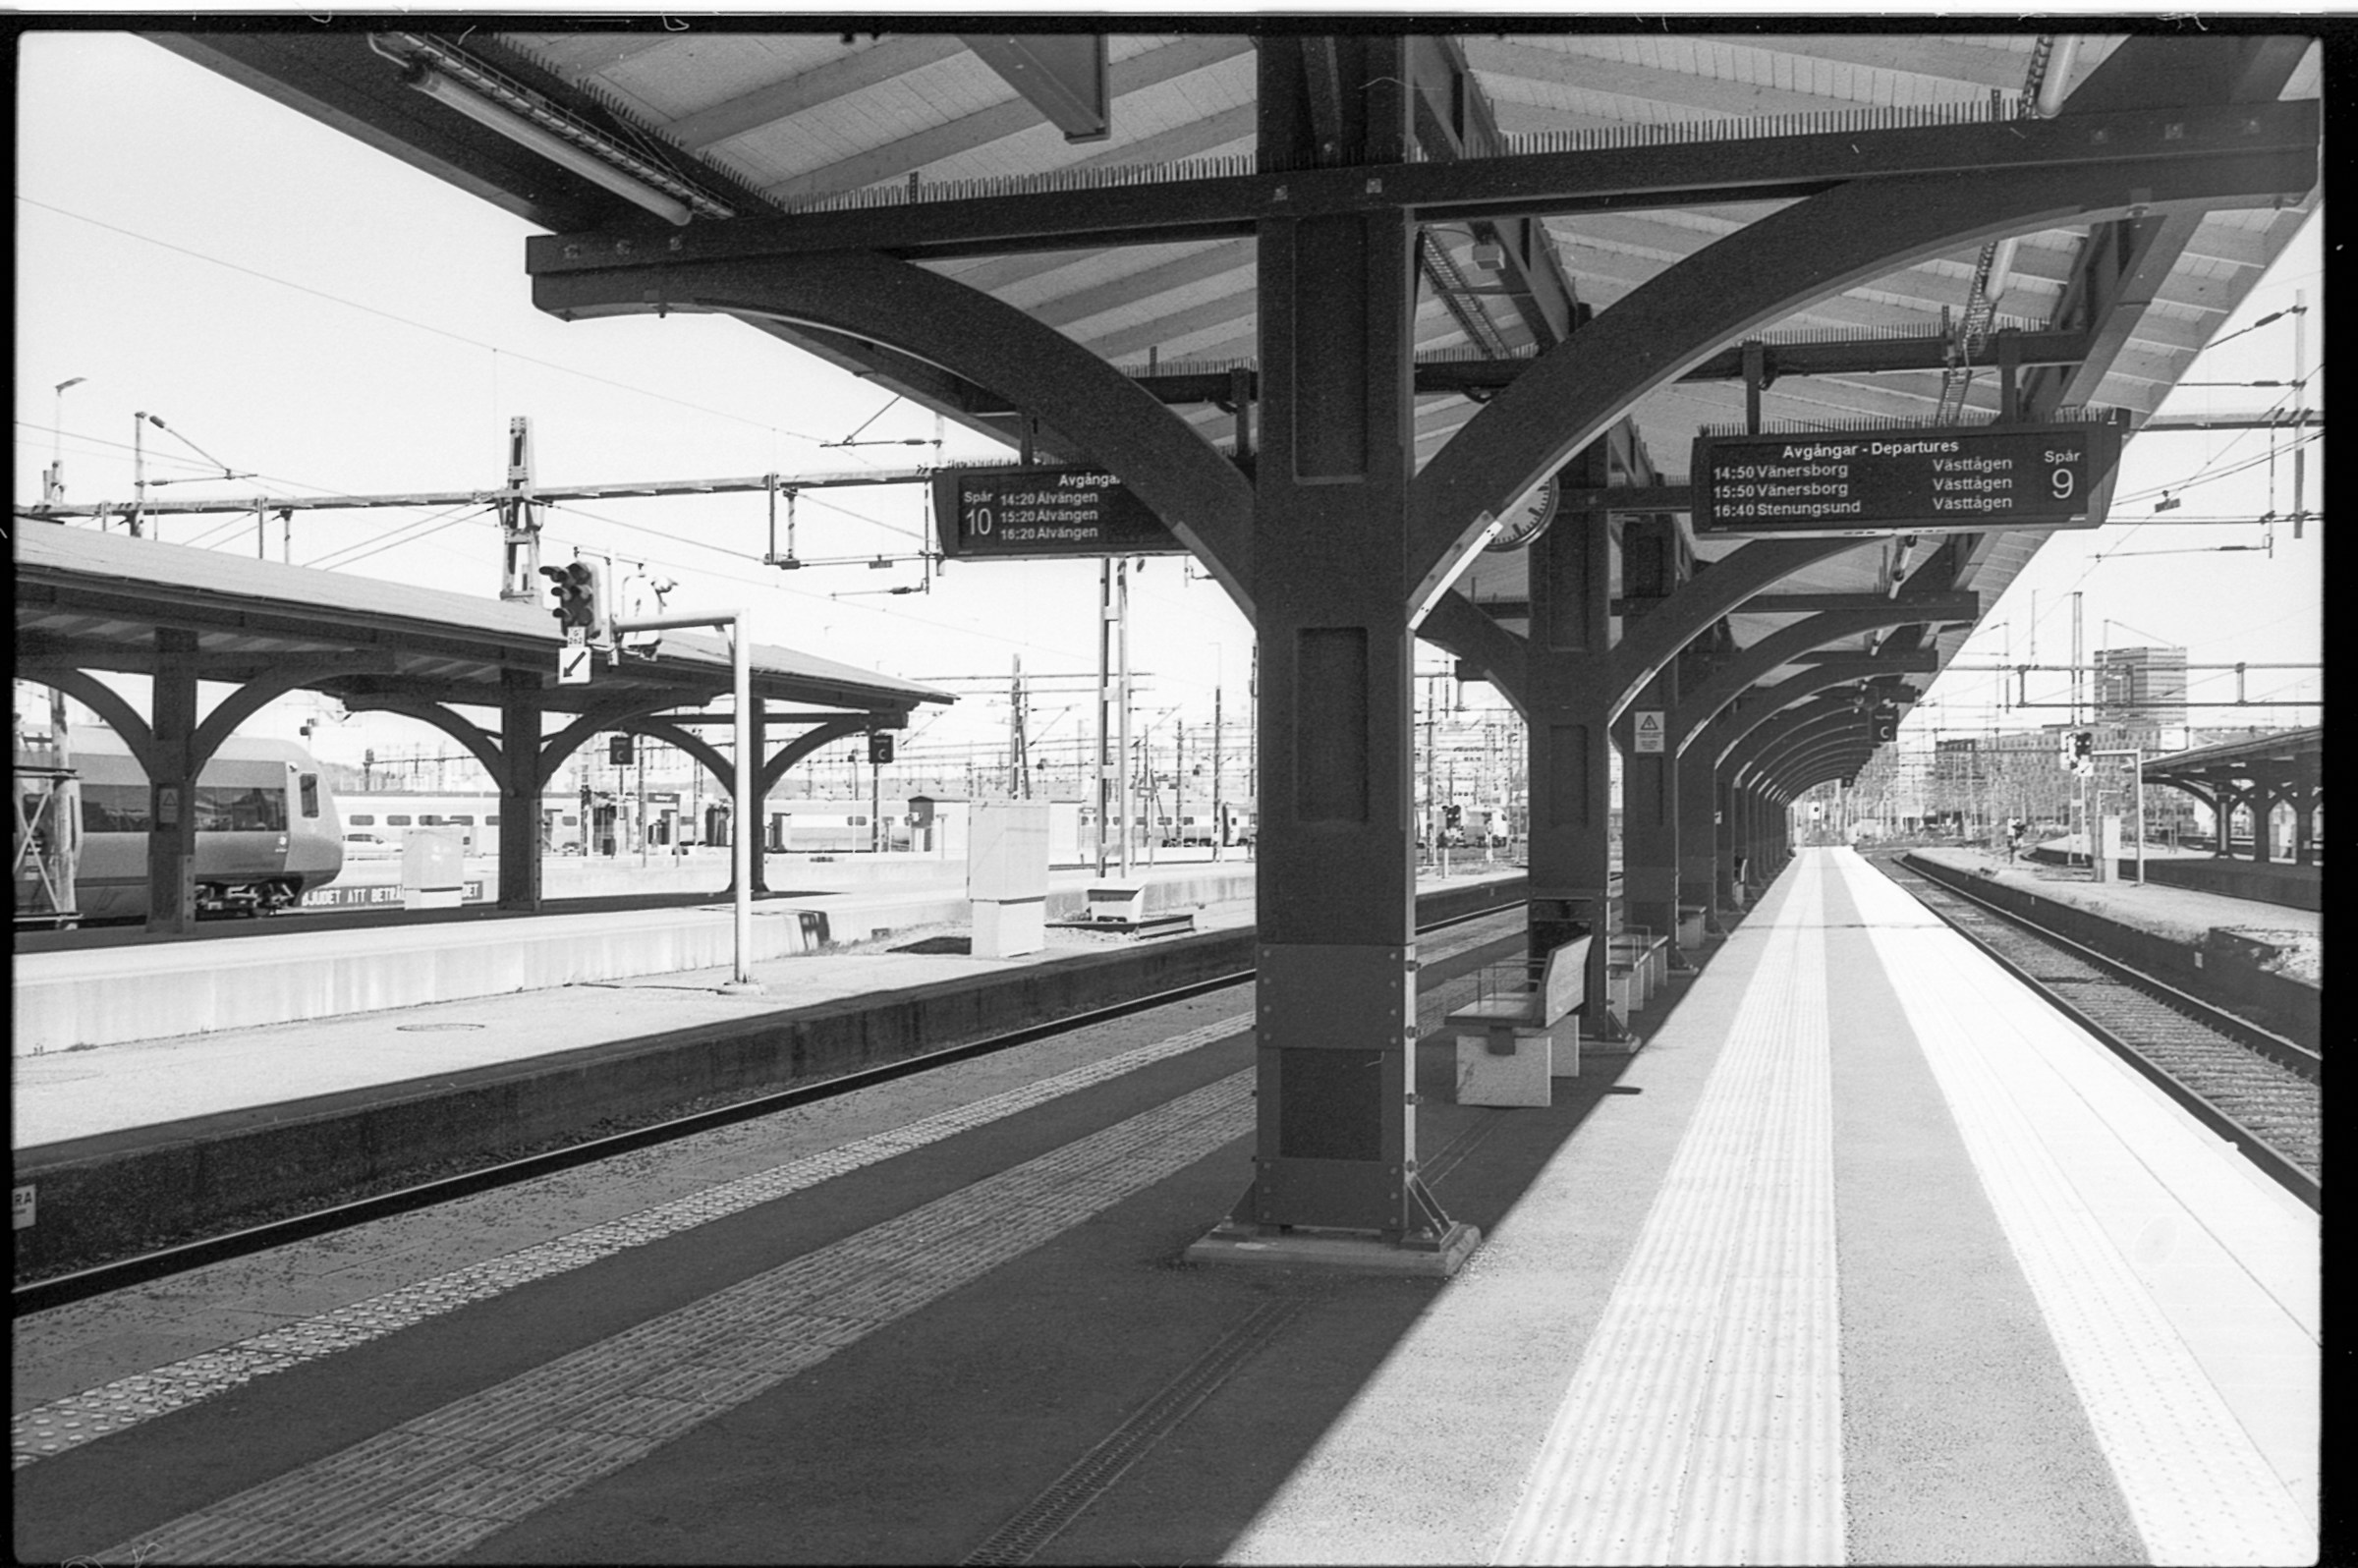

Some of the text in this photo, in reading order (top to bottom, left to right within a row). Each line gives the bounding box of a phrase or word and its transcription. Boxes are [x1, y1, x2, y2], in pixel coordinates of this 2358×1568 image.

[1782, 444, 1859, 461] Avgångar
[1871, 441, 1959, 458] Departures
[2045, 449, 2082, 466] Spår
[1713, 456, 2013, 479] 14:50 Vänersborg Västtågen
[1059, 472, 1120, 488] Avgånga
[1713, 476, 2013, 498] 15:50 Vänersborg Västtågen
[2052, 468, 2074, 499] 9
[964, 490, 993, 505] Spår
[1000, 492, 1036, 506] 14:20
[1713, 495, 2013, 517] 16:40 Stenungsund Västtågen
[966, 507, 991, 536] 10
[1000, 511, 1036, 524] 15:20
[1000, 528, 1036, 540] 16:20
[347, 887, 366, 903] ATT
